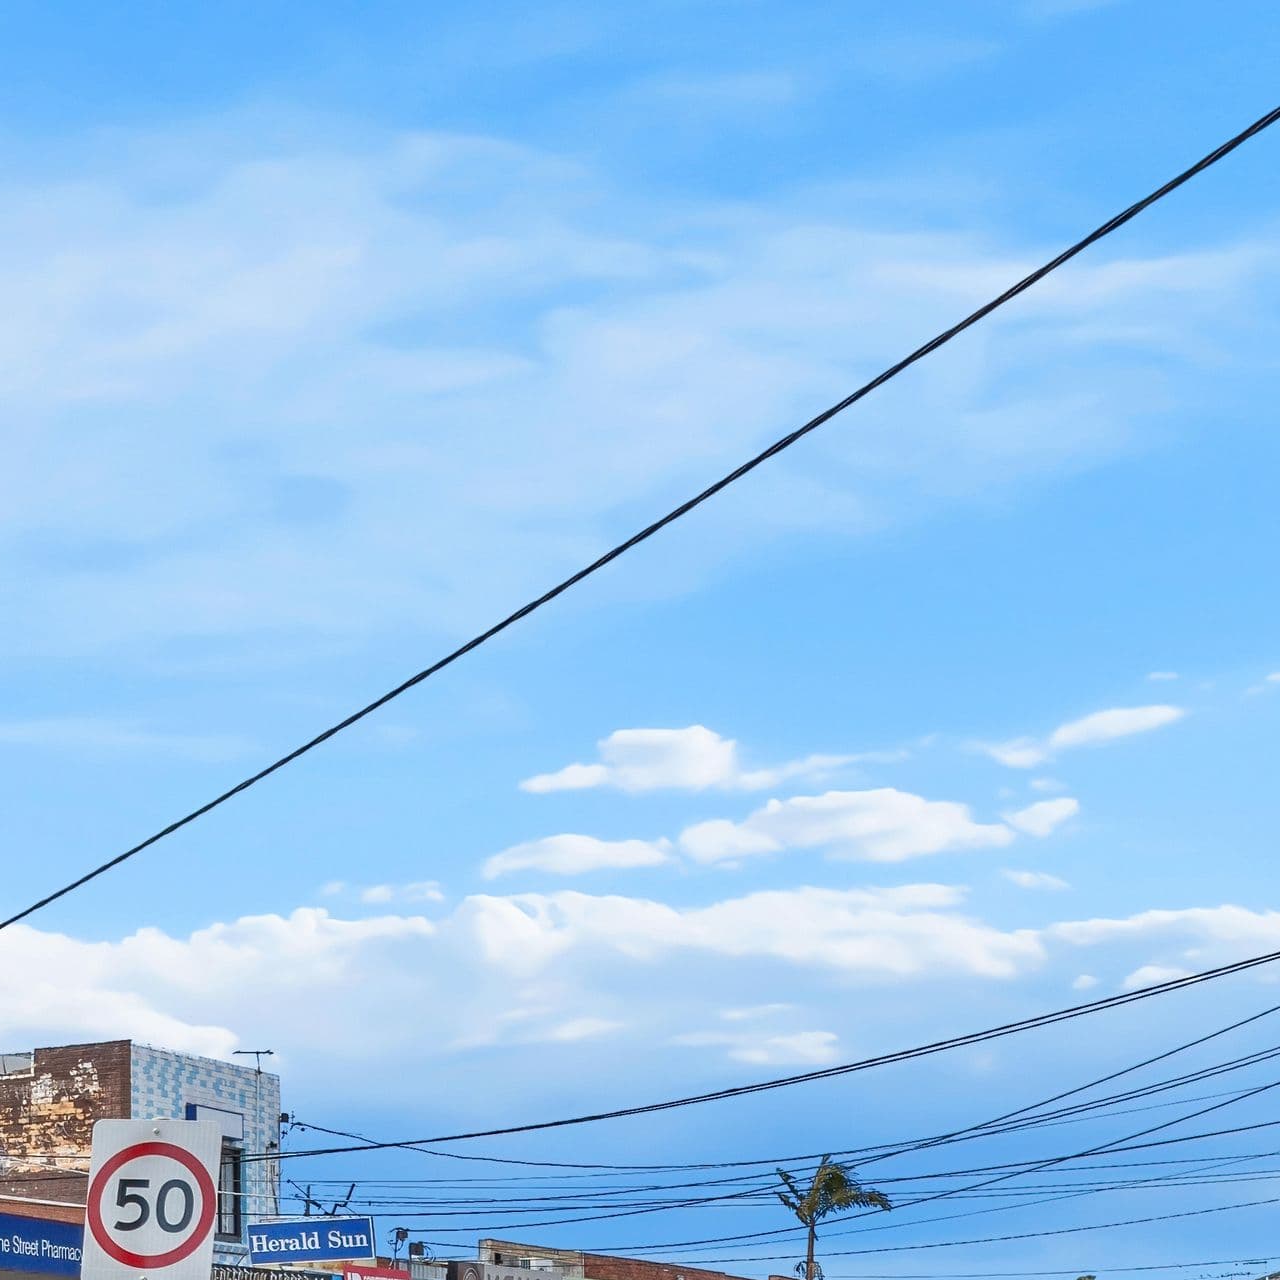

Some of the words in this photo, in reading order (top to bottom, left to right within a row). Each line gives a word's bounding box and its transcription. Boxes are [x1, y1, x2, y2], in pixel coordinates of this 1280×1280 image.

[114, 1178, 194, 1233] 50
[12, 1235, 39, 1257] Street
[41, 1239, 82, 1263] Pharmacy
[250, 1232, 320, 1253] Herald
[328, 1230, 368, 1249] Sun
